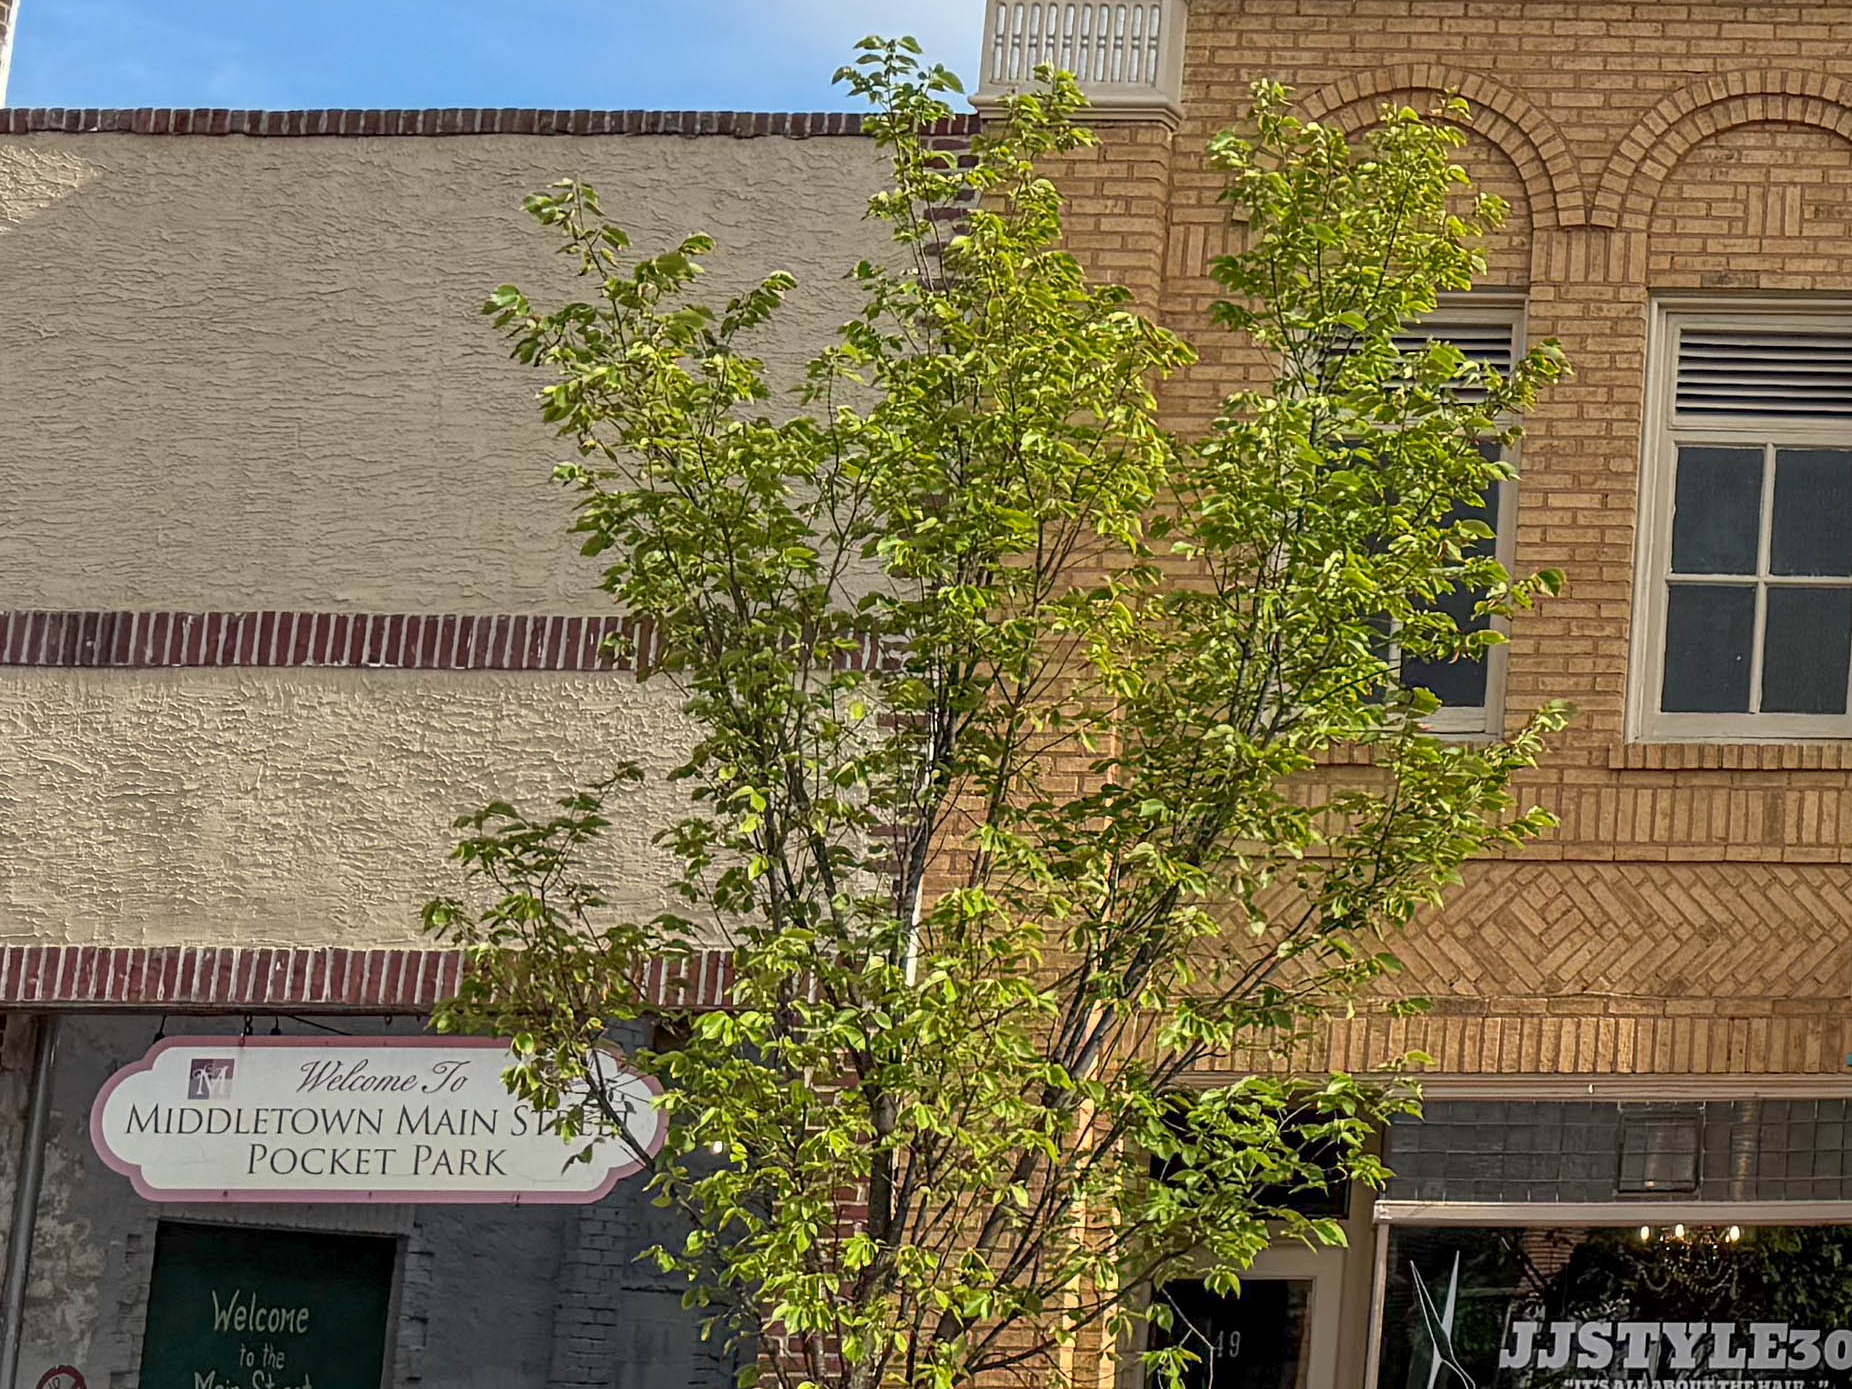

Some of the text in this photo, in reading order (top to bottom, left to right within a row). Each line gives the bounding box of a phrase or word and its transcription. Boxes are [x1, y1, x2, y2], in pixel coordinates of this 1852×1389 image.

[297, 1059, 471, 1093] Welcome To
[125, 1103, 382, 1135] MIDDLETOWN
[396, 1104, 498, 1135] MAIN
[247, 1143, 507, 1177] POCKET PARK
[211, 1289, 309, 1333] Welcome
[240, 1342, 285, 1370] to the
